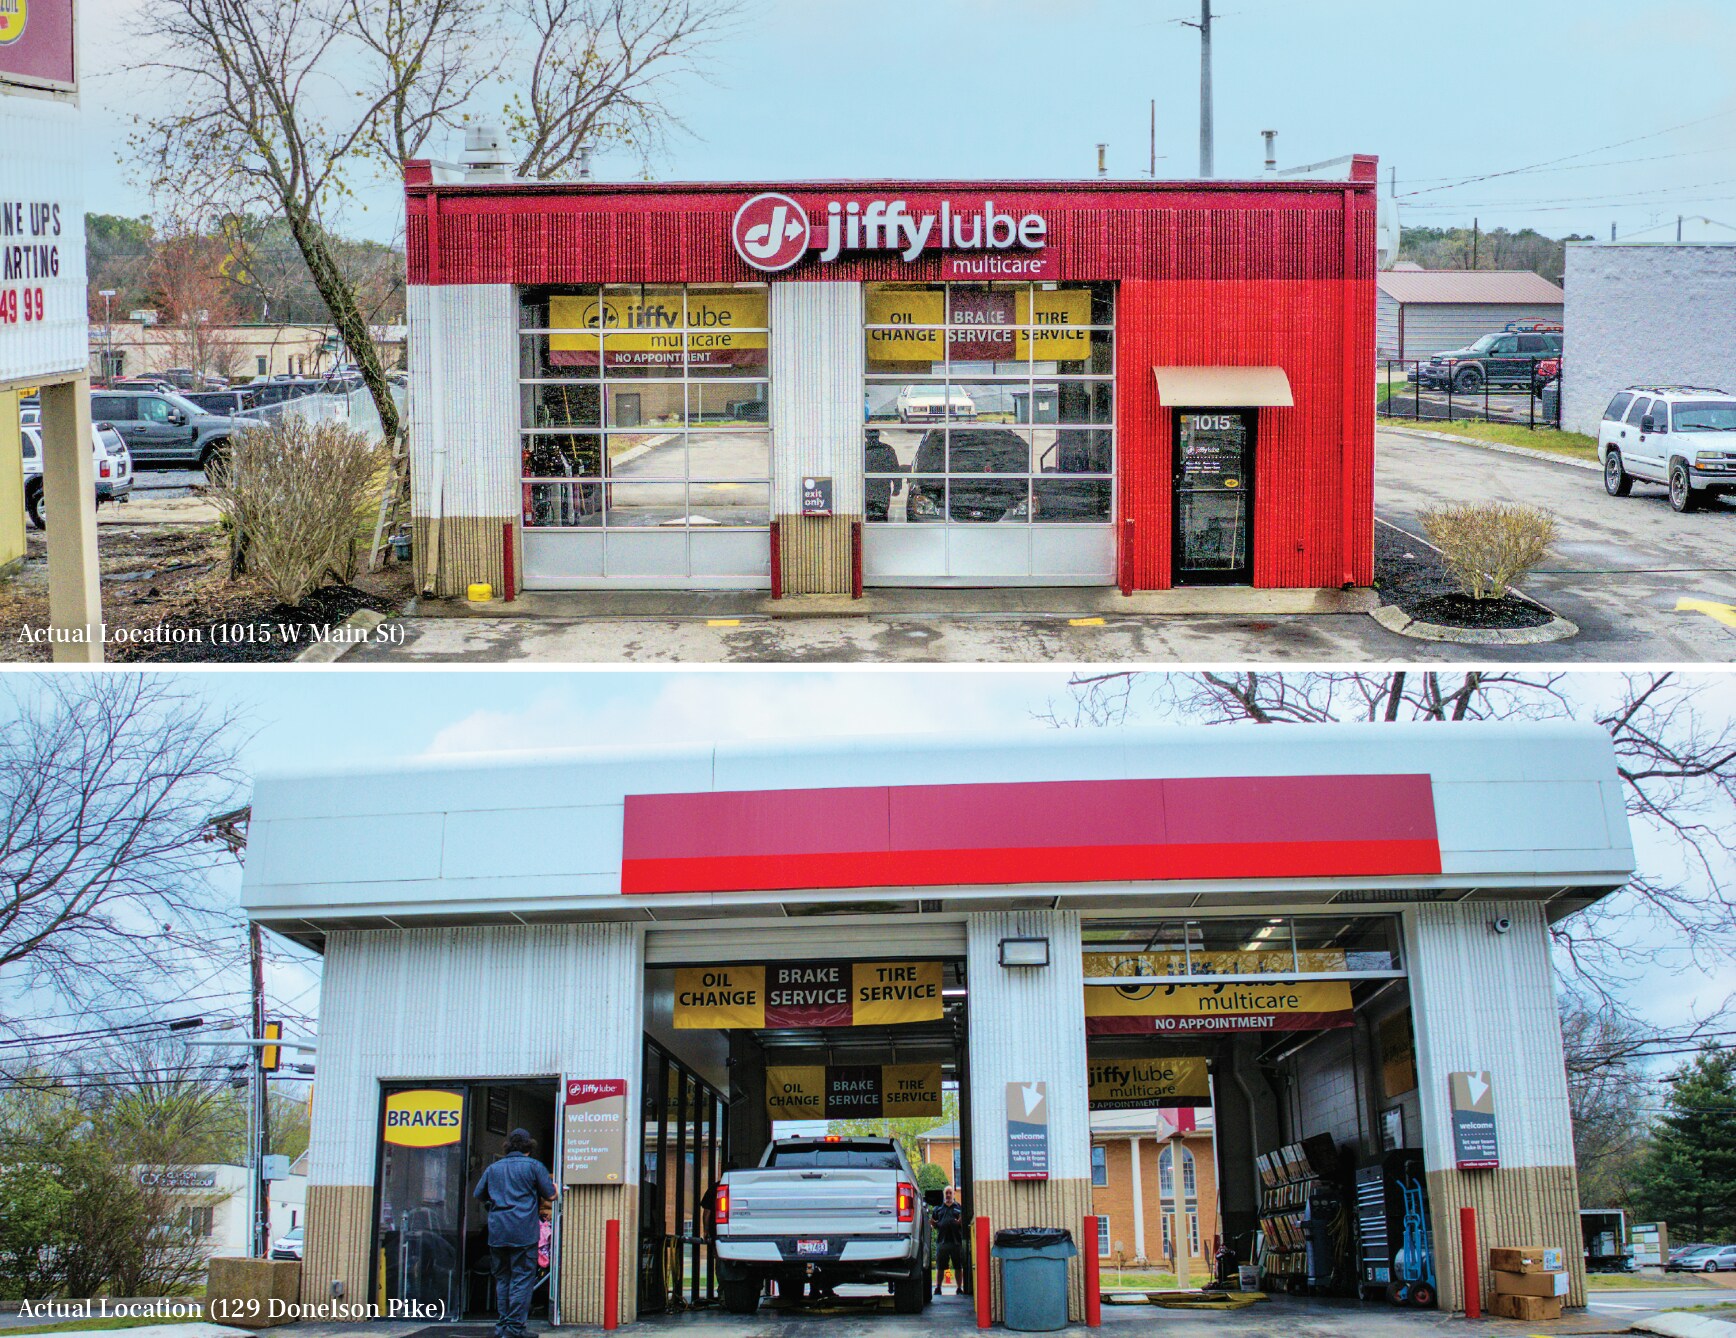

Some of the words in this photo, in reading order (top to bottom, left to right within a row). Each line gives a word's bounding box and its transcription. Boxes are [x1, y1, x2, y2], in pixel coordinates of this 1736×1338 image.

[30, 202, 60, 236] UPS
[821, 201, 935, 262] jiffy
[942, 201, 1047, 248] lube
[953, 256, 1042, 273] multicare
[891, 313, 916, 324] OIL
[954, 311, 1004, 323] BRAKE
[1036, 312, 1068, 324] TIRE
[872, 329, 936, 341] CHANGE
[949, 330, 1011, 342] SERVICE
[1022, 330, 1084, 340] SERVICE
[616, 353, 631, 362] NO
[1193, 416, 1230, 430] 1015
[805, 489, 822, 498] exit
[805, 498, 824, 508] only
[702, 973, 732, 987] OIL
[779, 968, 839, 984] BRAKE
[876, 967, 916, 982] TIRE
[679, 991, 756, 1006] CHANGE
[770, 988, 846, 1005] SERVICE
[859, 984, 936, 1001] SERVICE
[1199, 992, 1298, 1010] multicare
[1155, 1019, 1175, 1029] NO
[1179, 1016, 1275, 1029] APPOINTMENT
[1089, 1066, 1130, 1087] jiffy
[1133, 1066, 1174, 1082] lube
[783, 1084, 803, 1093] OIL
[833, 1080, 873, 1091] BRAKE
[898, 1080, 924, 1089] TIRE
[887, 1092, 937, 1102] SERVICE
[1110, 1085, 1175, 1097] multicare
[769, 1096, 819, 1106] CHANGE
[829, 1094, 879, 1105] SERVICE
[1098, 1099, 1160, 1108] APPOINTMENT
[388, 1110, 460, 1126] BRAKES
[568, 1112, 619, 1122] welcome
[1010, 1132, 1045, 1140] welcome
